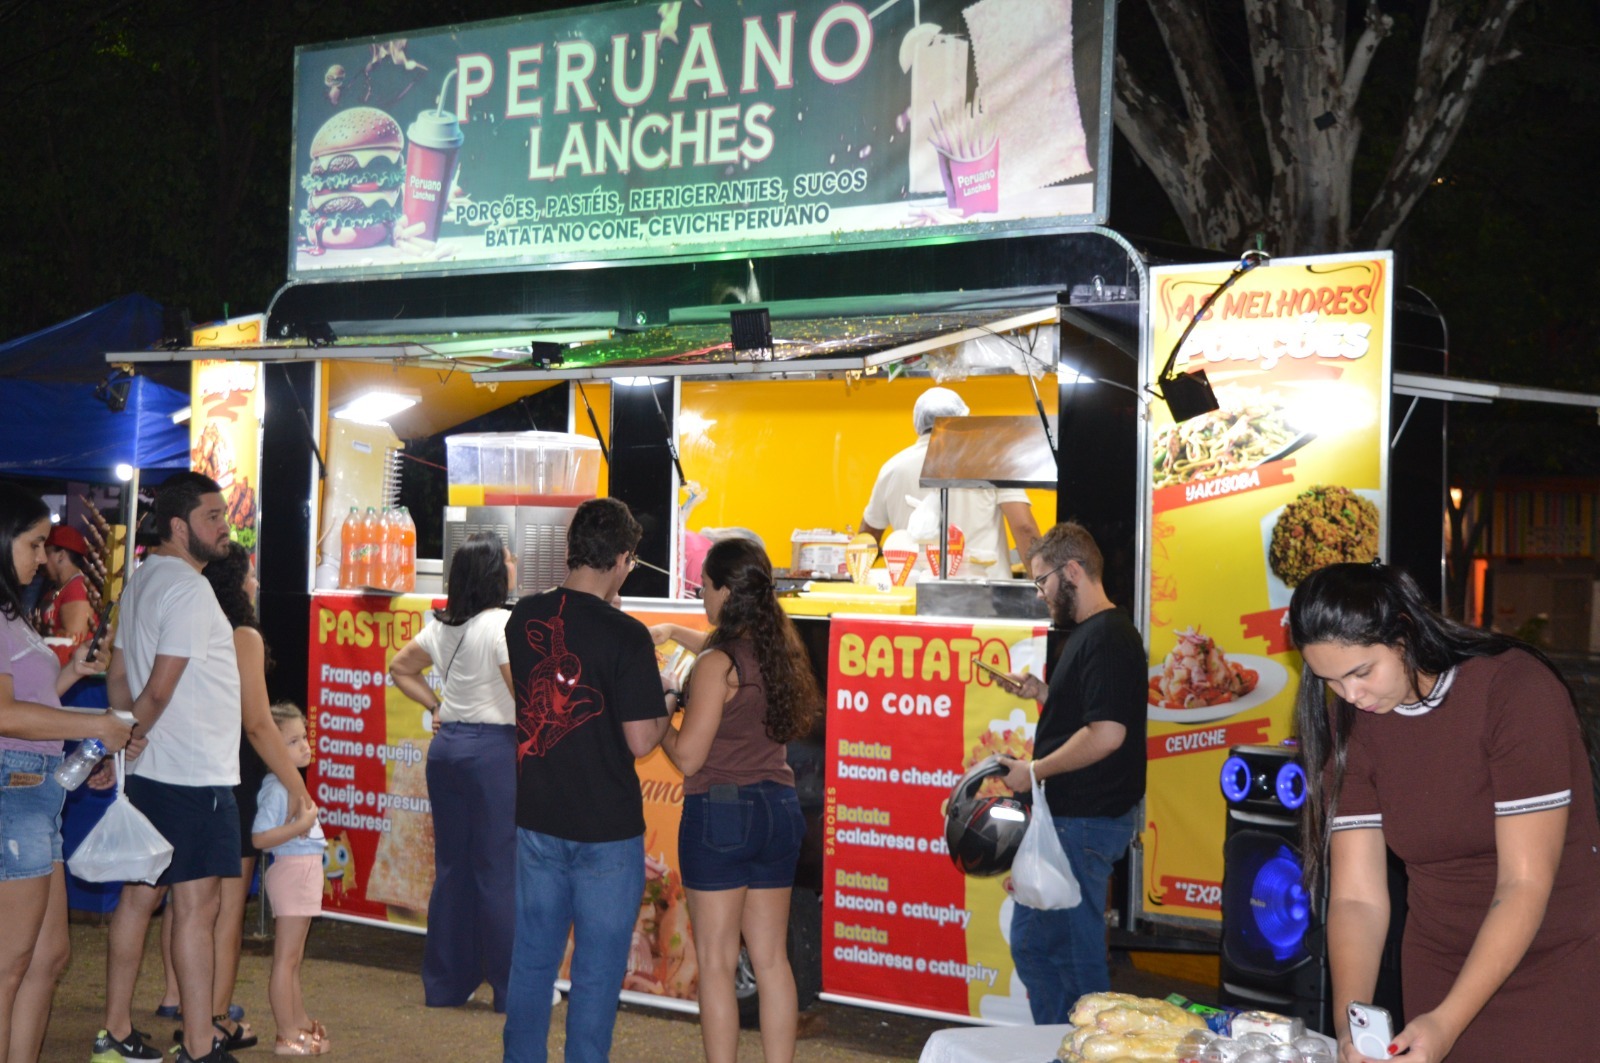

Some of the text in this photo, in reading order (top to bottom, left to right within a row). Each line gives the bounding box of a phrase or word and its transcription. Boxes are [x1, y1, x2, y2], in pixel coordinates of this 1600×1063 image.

[455, 3, 873, 124] PERUANO
[528, 103, 774, 180] LANCHES
[410, 175, 442, 192] Peruano
[957, 169, 996, 188] Peruano
[963, 182, 991, 197] Lanches
[412, 189, 436, 202] Lanches
[455, 168, 867, 225] PORÇÕES, PASTÉIS, REFRIGERANTES, SUCOS
[485, 204, 829, 247] BATATA NO CONE, CEVICHE PERUANO
[1176, 285, 1372, 322] AS MELHORES
[1185, 470, 1260, 500] YAKISOBA
[838, 633, 1011, 687] BATATA
[321, 664, 371, 690] Frango
[373, 673, 383, 686] e
[320, 688, 371, 714] Frango
[836, 689, 952, 718] no cone
[319, 712, 364, 733] Carne
[319, 735, 422, 768] Carne e queijo
[837, 739, 891, 761] Batata
[1165, 729, 1226, 753] CEVICHE
[318, 759, 355, 780] Pizza
[837, 760, 887, 782] bacon
[889, 768, 899, 784] e
[318, 783, 432, 813] Queijo e presun
[317, 808, 392, 832] Calabresa
[826, 787, 836, 856] SABORES
[836, 804, 890, 826] Batata
[836, 828, 915, 851] calabresa
[917, 838, 928, 853] e
[835, 869, 889, 892] Batata
[834, 890, 972, 929] bacon e catupiry
[834, 922, 888, 945] Batata
[833, 945, 998, 987] calabresa e catupiry
